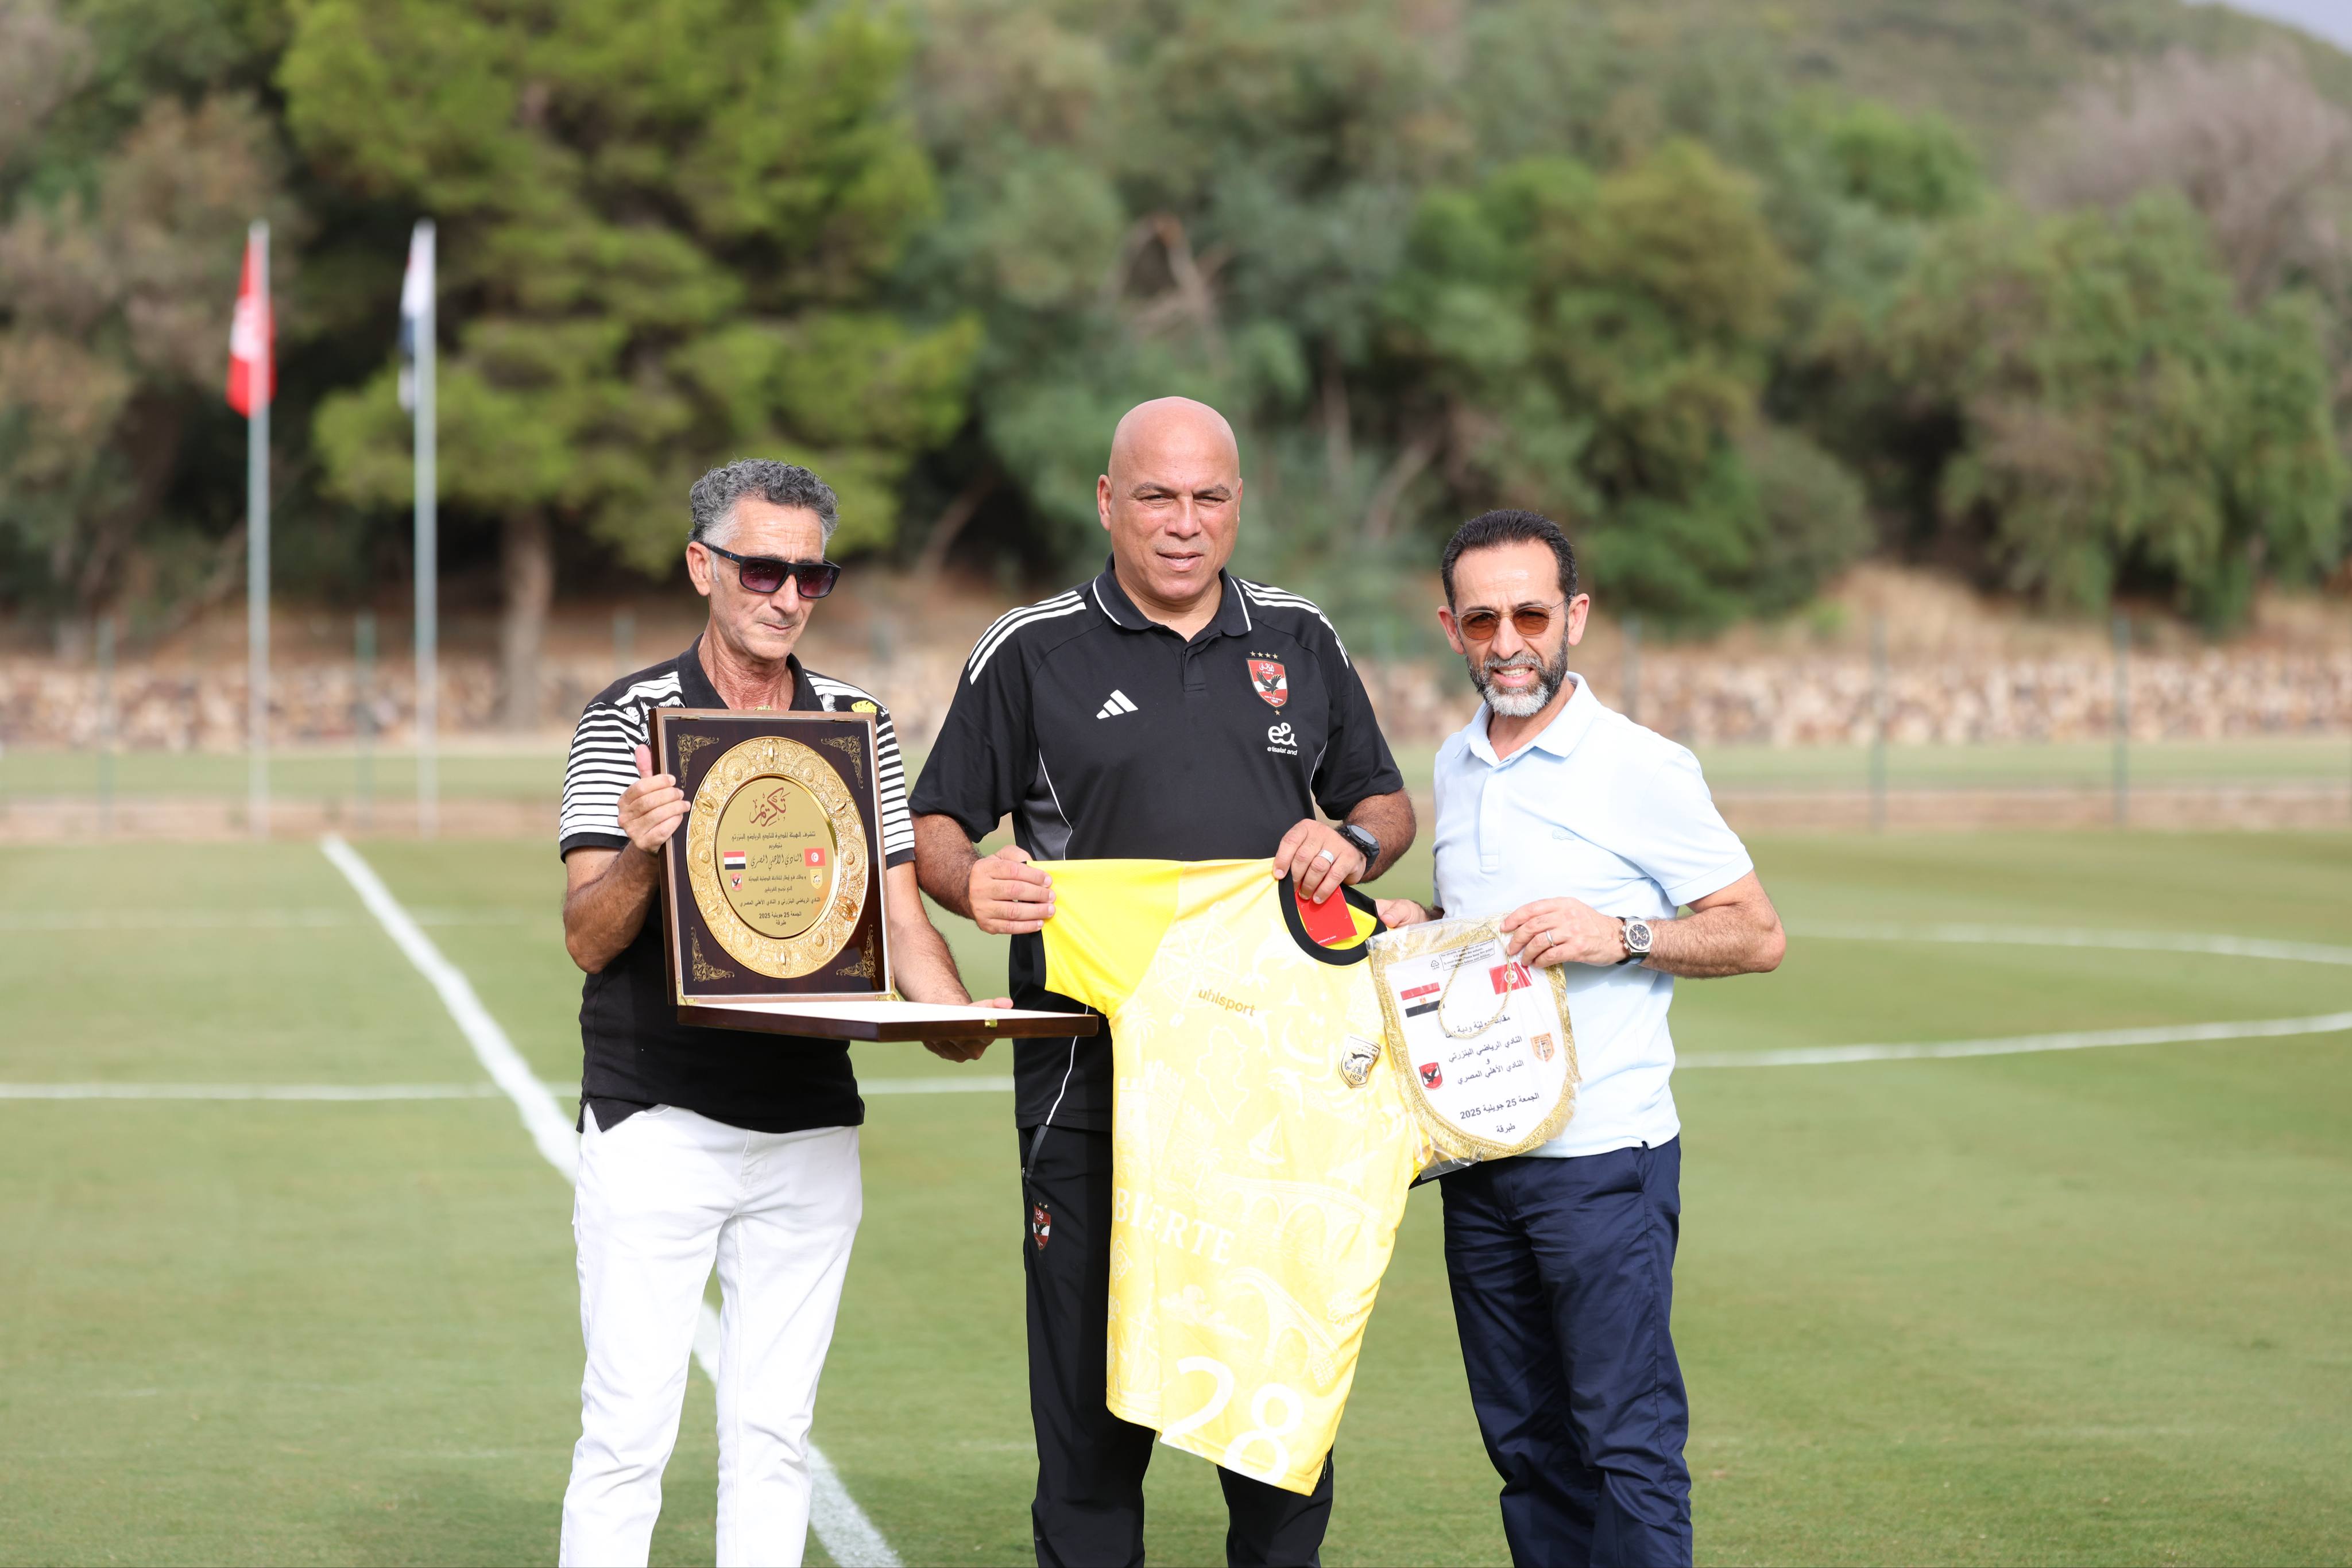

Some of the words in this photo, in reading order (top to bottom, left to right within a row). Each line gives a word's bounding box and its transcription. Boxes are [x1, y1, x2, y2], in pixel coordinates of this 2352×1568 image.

[1287, 747, 1298, 756] and
[1198, 989, 1256, 1016] uhlsport
[1457, 1025, 1472, 1034] ودية
[1504, 1035, 1522, 1048] النادي
[1476, 1041, 1502, 1056] الرياضي
[1449, 1048, 1475, 1063] البنزرتي
[1485, 1065, 1504, 1078] الأهلي
[1506, 1059, 1525, 1073] النادي
[1349, 1073, 1363, 1082] 1928
[1457, 1070, 1483, 1085] المصري
[1506, 1098, 1517, 1108] 25
[1518, 1092, 1539, 1103] الجمعة
[1460, 1107, 1481, 1120] 2025
[1483, 1104, 1504, 1113] جويلية
[1496, 1123, 1516, 1134] طبرقة
[1115, 1187, 1235, 1265] BIERTE
[1159, 1356, 1305, 1485] 28
